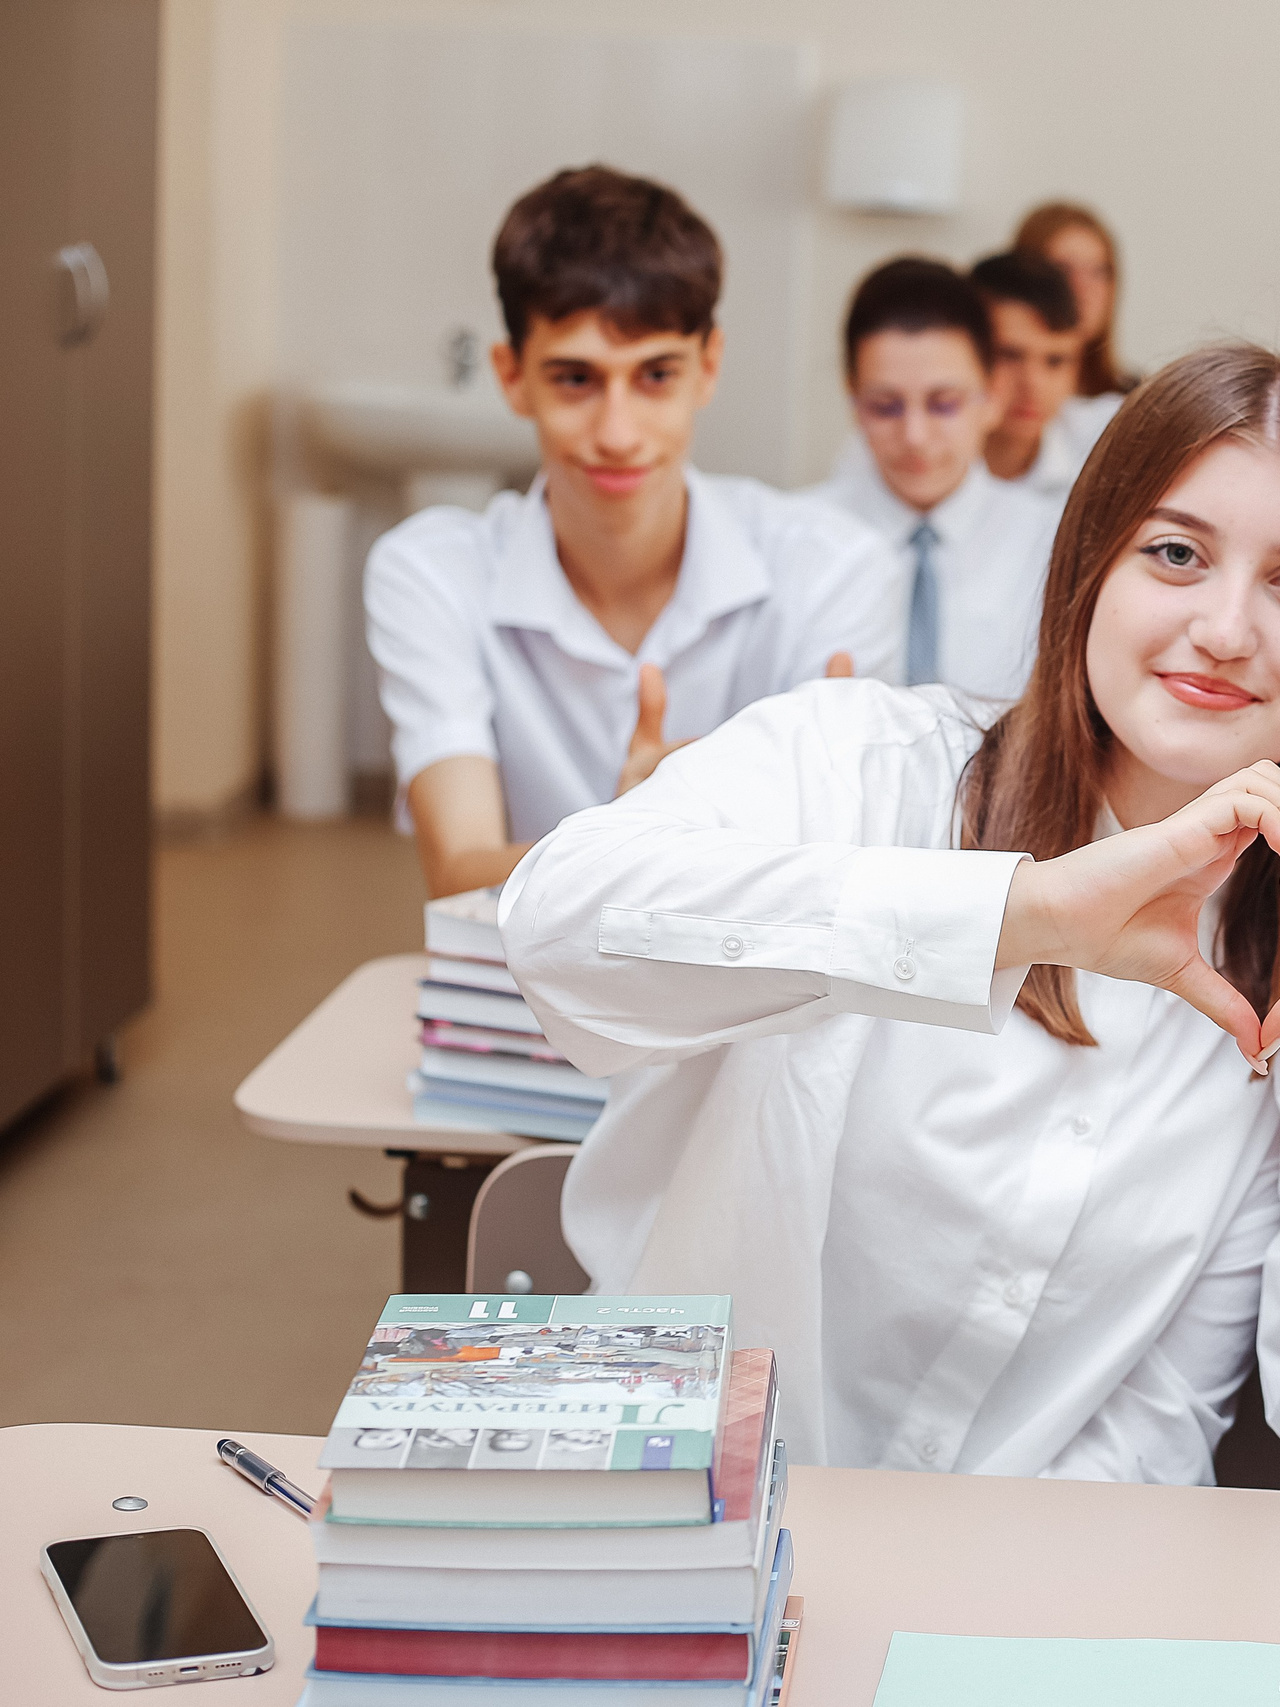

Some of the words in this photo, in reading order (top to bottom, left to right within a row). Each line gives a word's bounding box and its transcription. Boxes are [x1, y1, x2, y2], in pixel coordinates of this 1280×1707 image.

[468, 1301, 518, 1319] 11
[596, 1307, 612, 1315] 2
[617, 1306, 685, 1315] Часть
